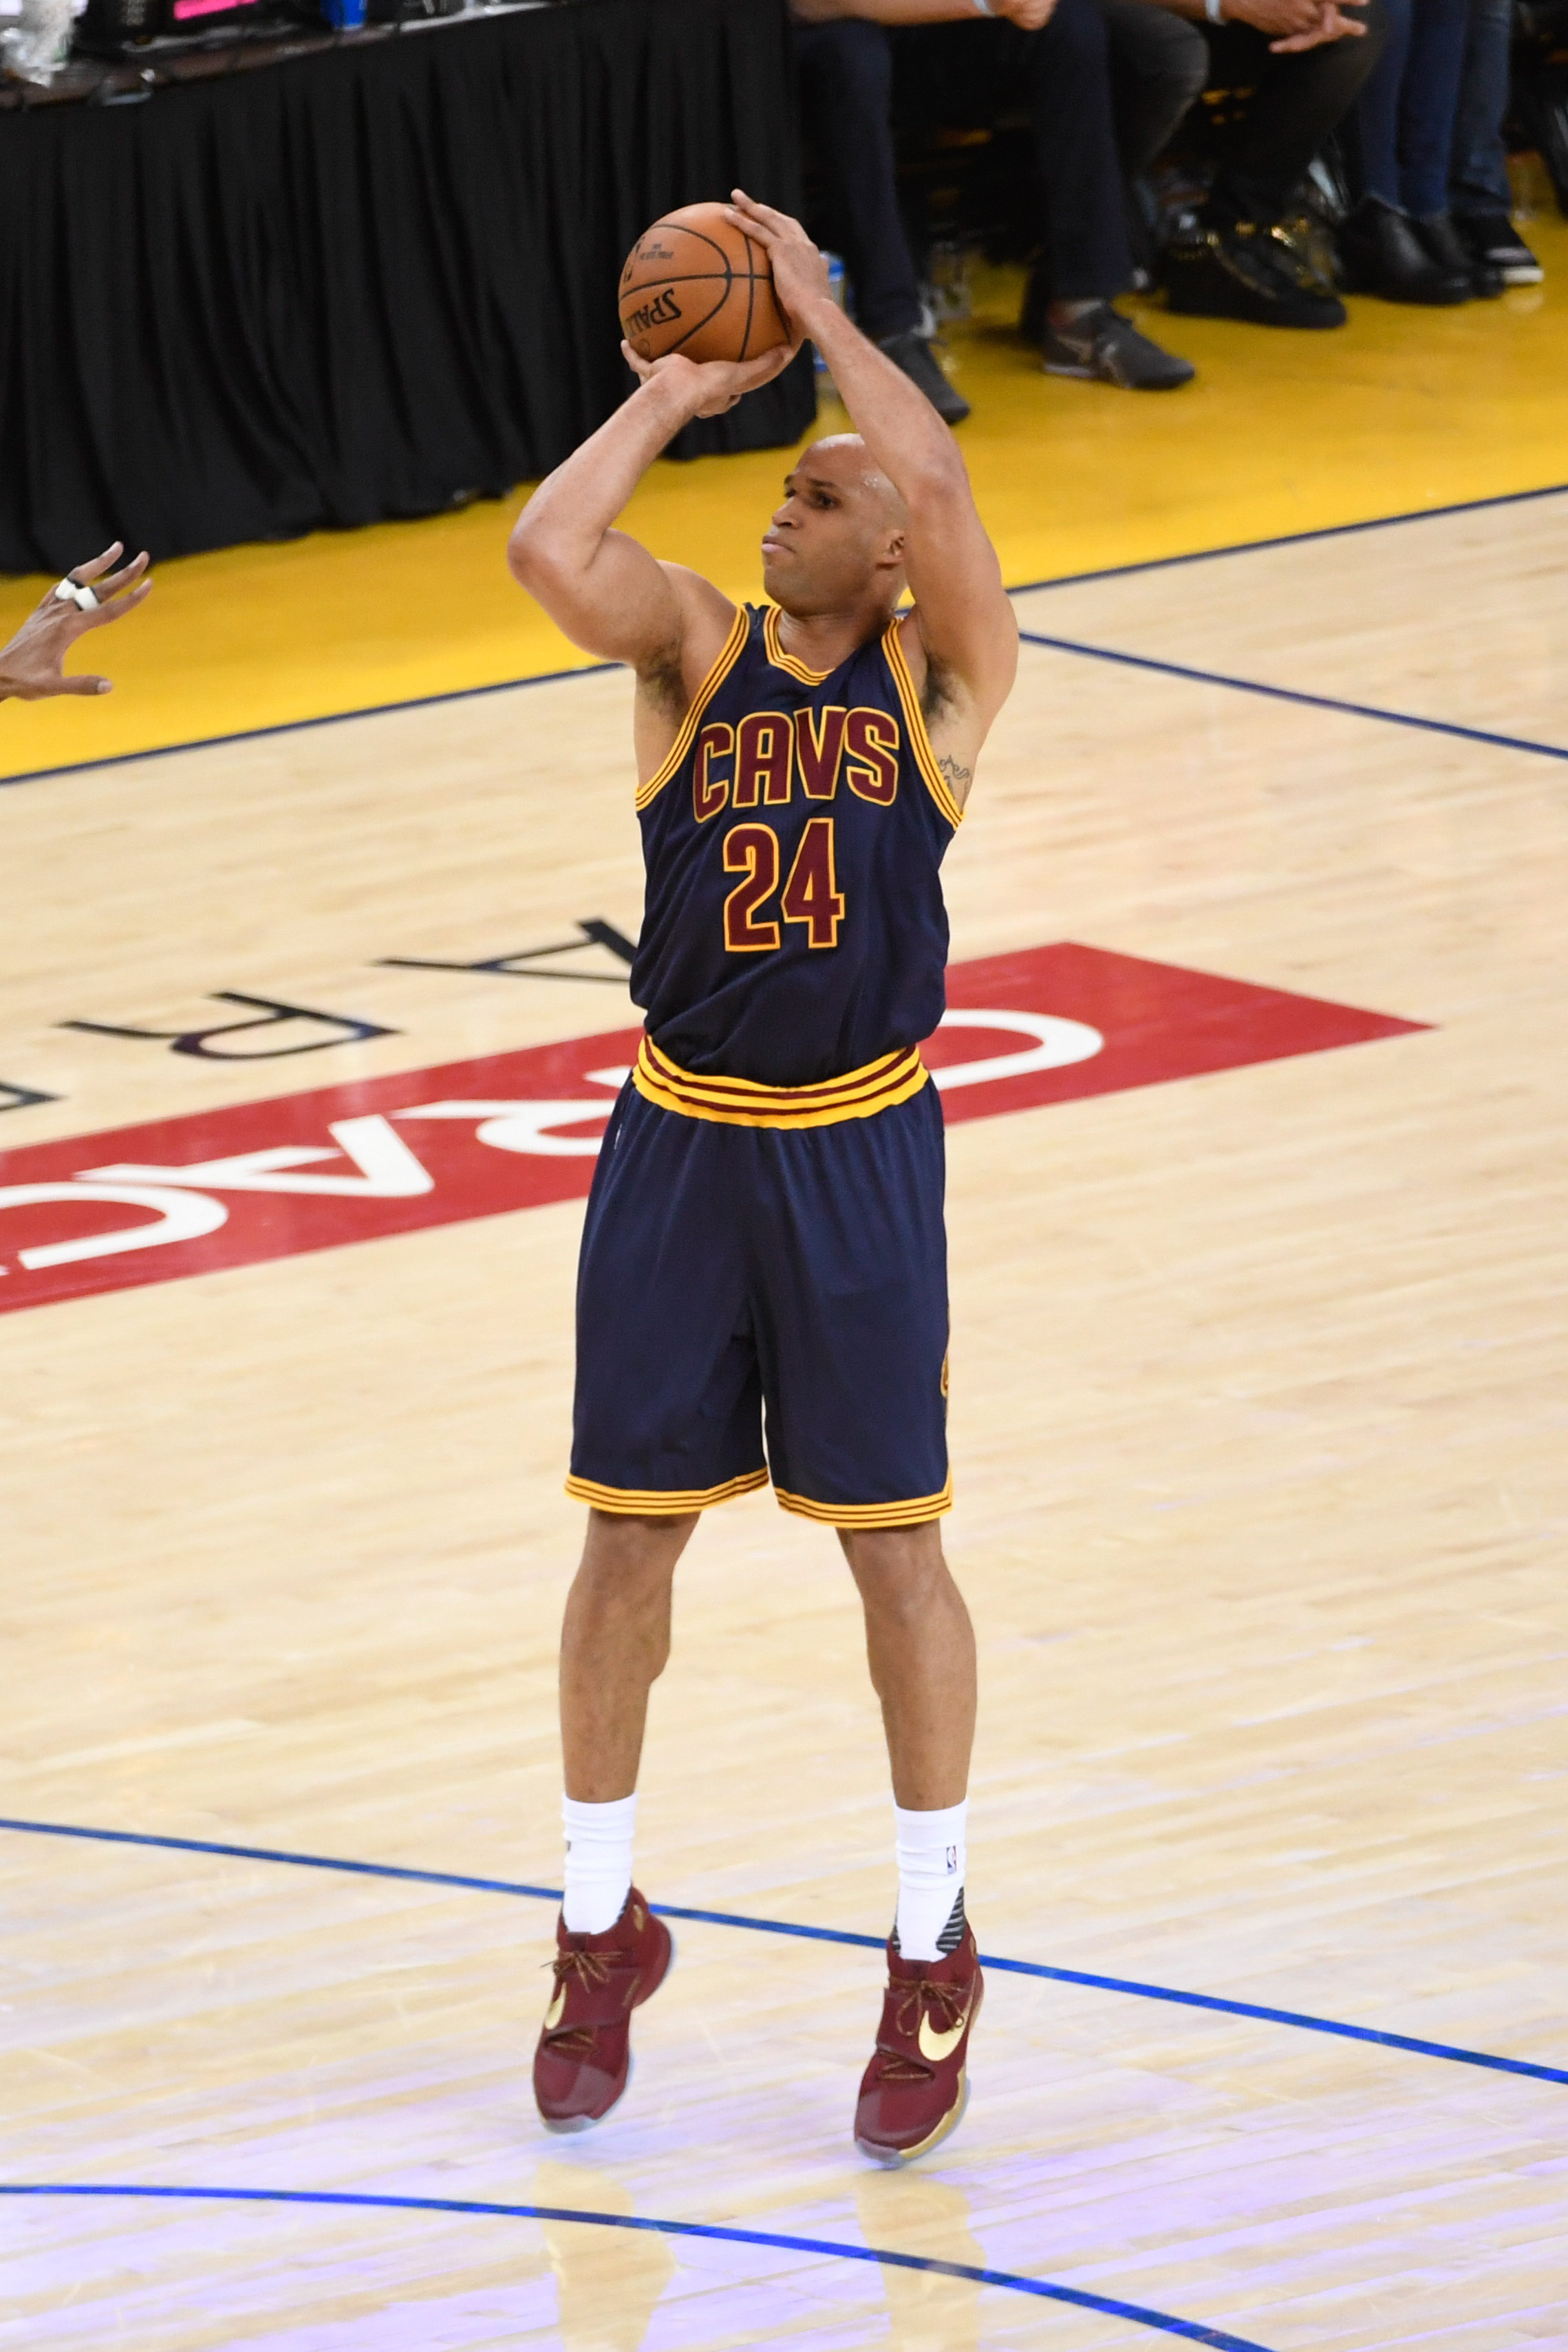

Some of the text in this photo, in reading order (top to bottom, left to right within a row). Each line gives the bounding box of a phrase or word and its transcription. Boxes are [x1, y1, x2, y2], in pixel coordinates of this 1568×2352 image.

[625, 288, 682, 337] SPAL
[693, 705, 899, 823] CAVS
[723, 817, 845, 951] 24
